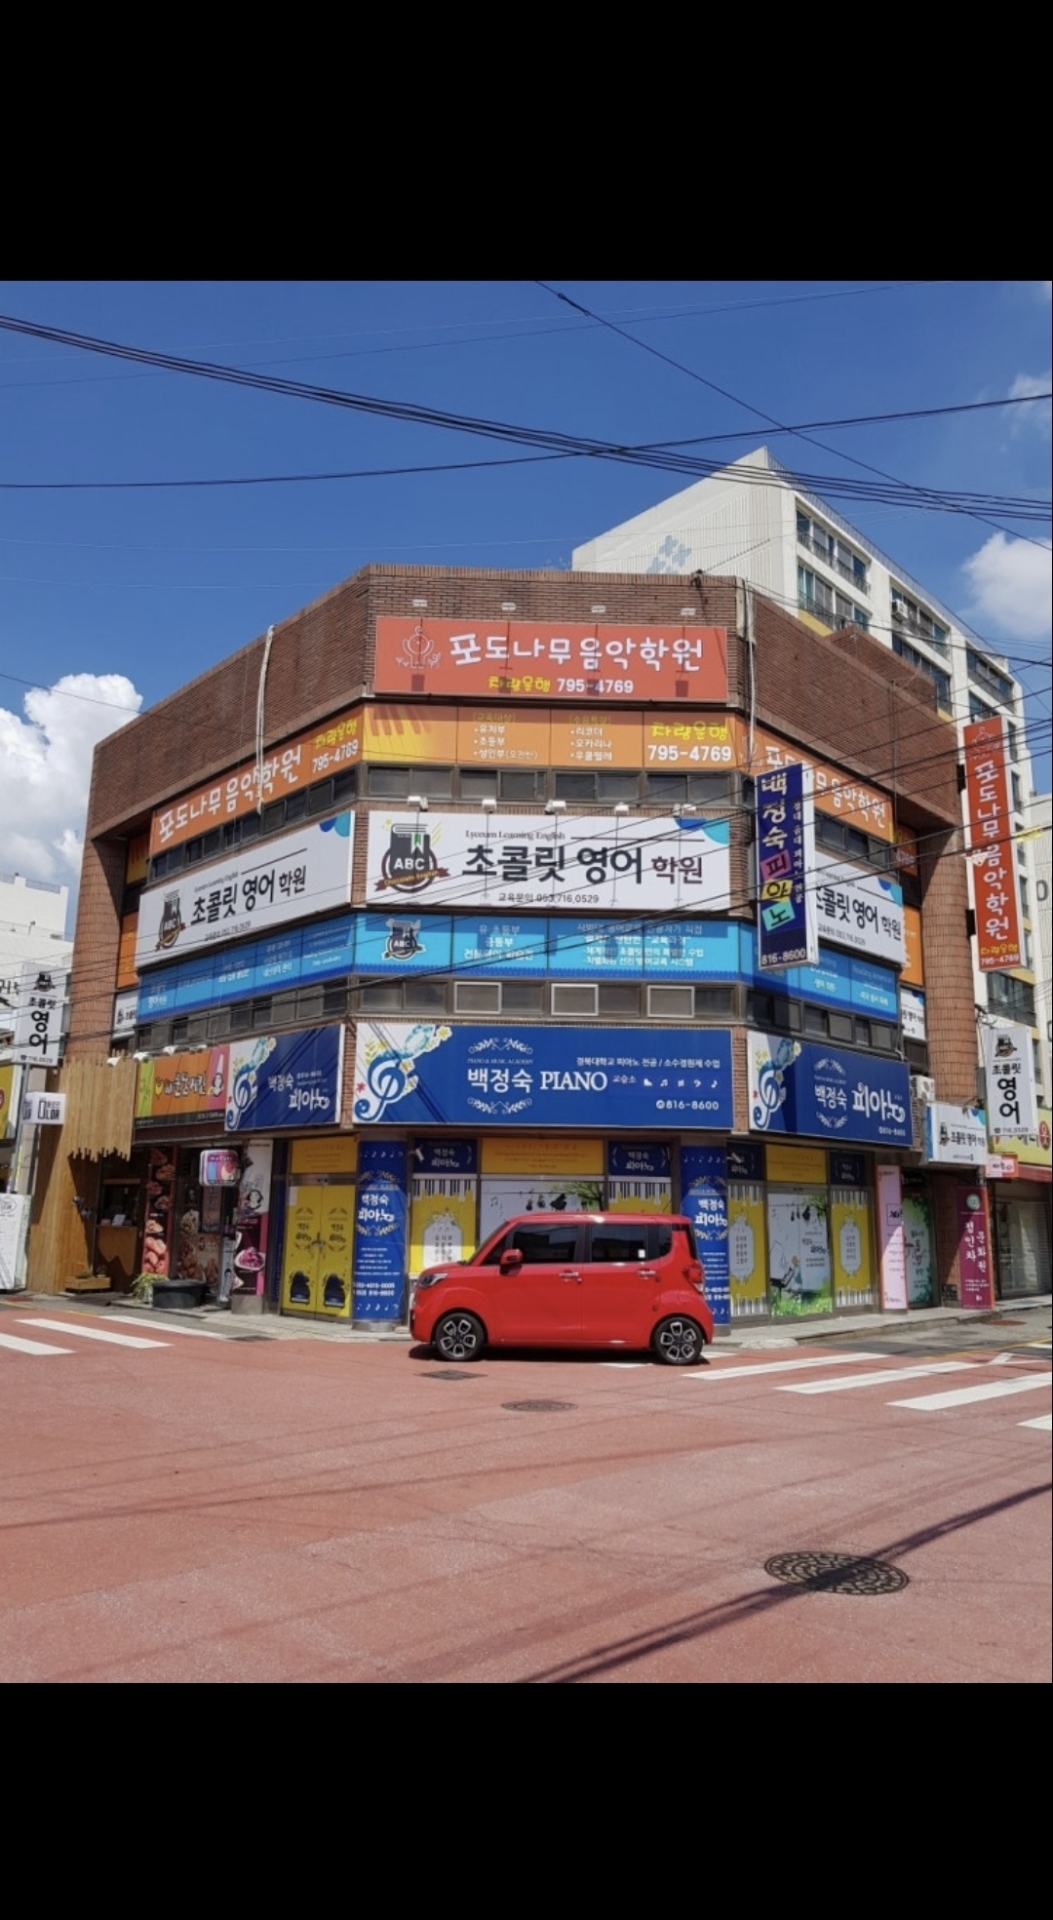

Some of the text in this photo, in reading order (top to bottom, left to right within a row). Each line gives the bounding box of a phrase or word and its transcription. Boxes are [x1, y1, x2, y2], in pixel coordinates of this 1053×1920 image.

[557, 677, 635, 694] 795-4769
[312, 738, 359, 774] 795-4769
[648, 744, 732, 762] 795-4769
[466, 830, 497, 841] Lyceum
[537, 832, 565, 842] English
[393, 858, 425, 871] ABC
[462, 844, 703, 886] 초콜릿 영어 학원
[190, 865, 306, 926] 초콜릿 영어 학원
[852, 899, 879, 934] 영어
[882, 916, 902, 942] 학원
[762, 949, 806, 965] 816-8600
[28, 1010, 49, 1055] 영어
[577, 1057, 615, 1067] 경북대학교
[704, 1059, 720, 1069] 수업
[268, 1073, 295, 1093] 백정숙
[467, 1068, 533, 1093] 백정숙
[540, 1071, 608, 1091] PIANO
[289, 1087, 330, 1112] 피아노
[666, 1100, 719, 1110] 816-8600
[815, 1081, 906, 1123] 백정숙 피아노
[997, 1077, 1020, 1125] 영어
[362, 1194, 390, 1207] 백정숙
[358, 1207, 395, 1223] 피아노
